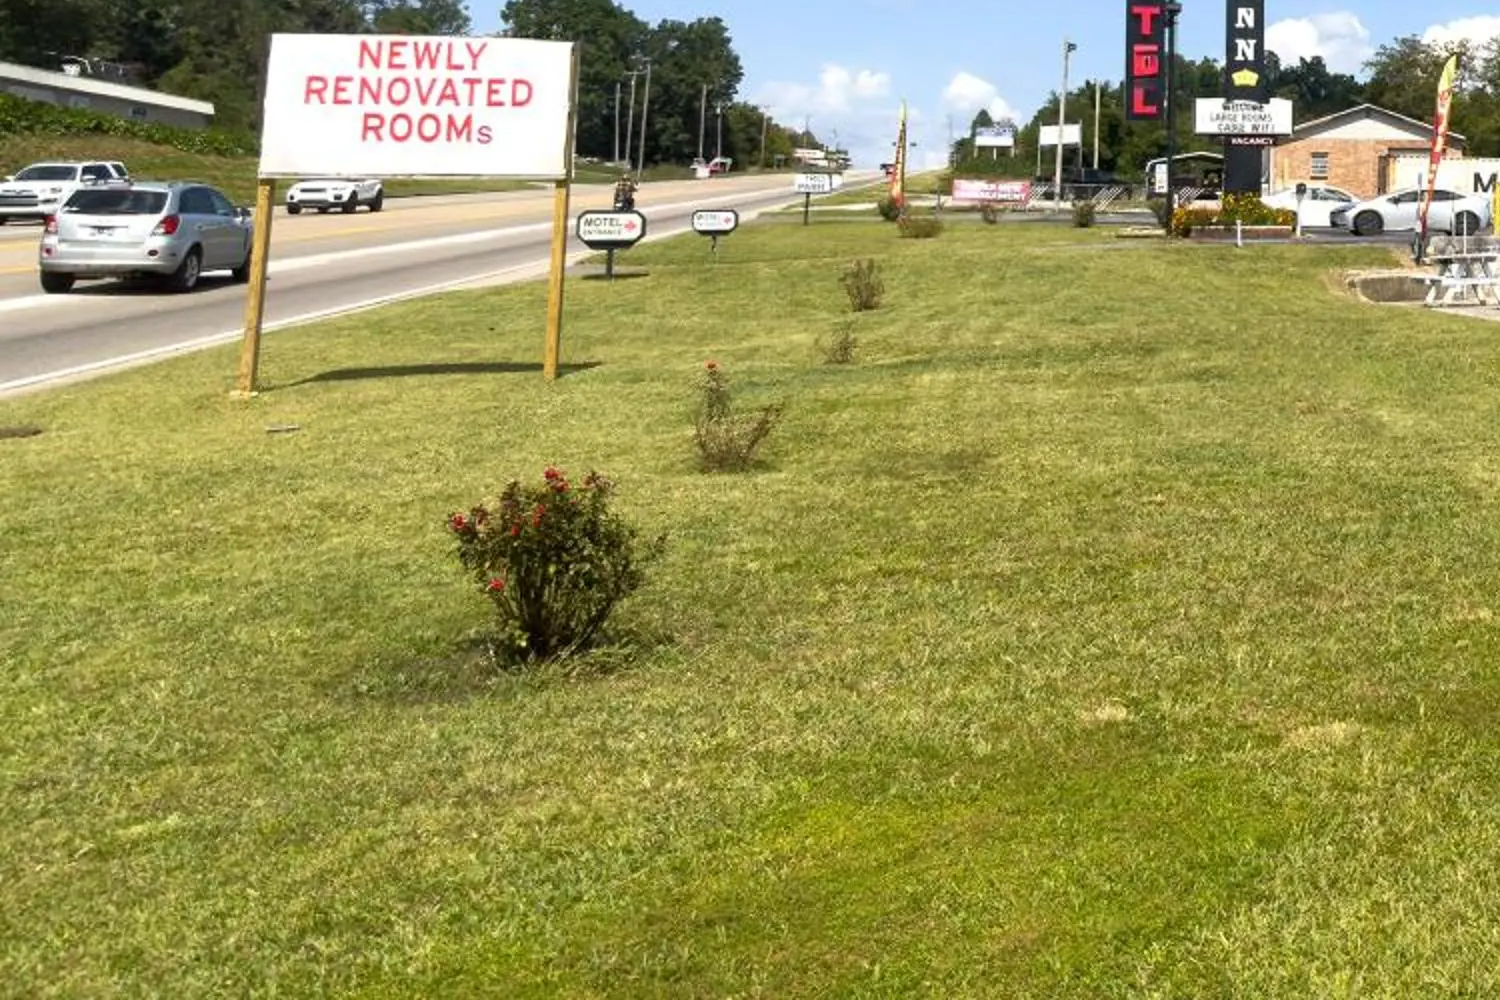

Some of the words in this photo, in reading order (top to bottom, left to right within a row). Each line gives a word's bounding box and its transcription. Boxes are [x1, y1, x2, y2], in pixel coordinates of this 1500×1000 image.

[358, 40, 488, 71] NEWLY
[303, 75, 534, 108] RENOVATED
[1231, 137, 1274, 145] VACANCY
[584, 217, 622, 227] MOTEL
